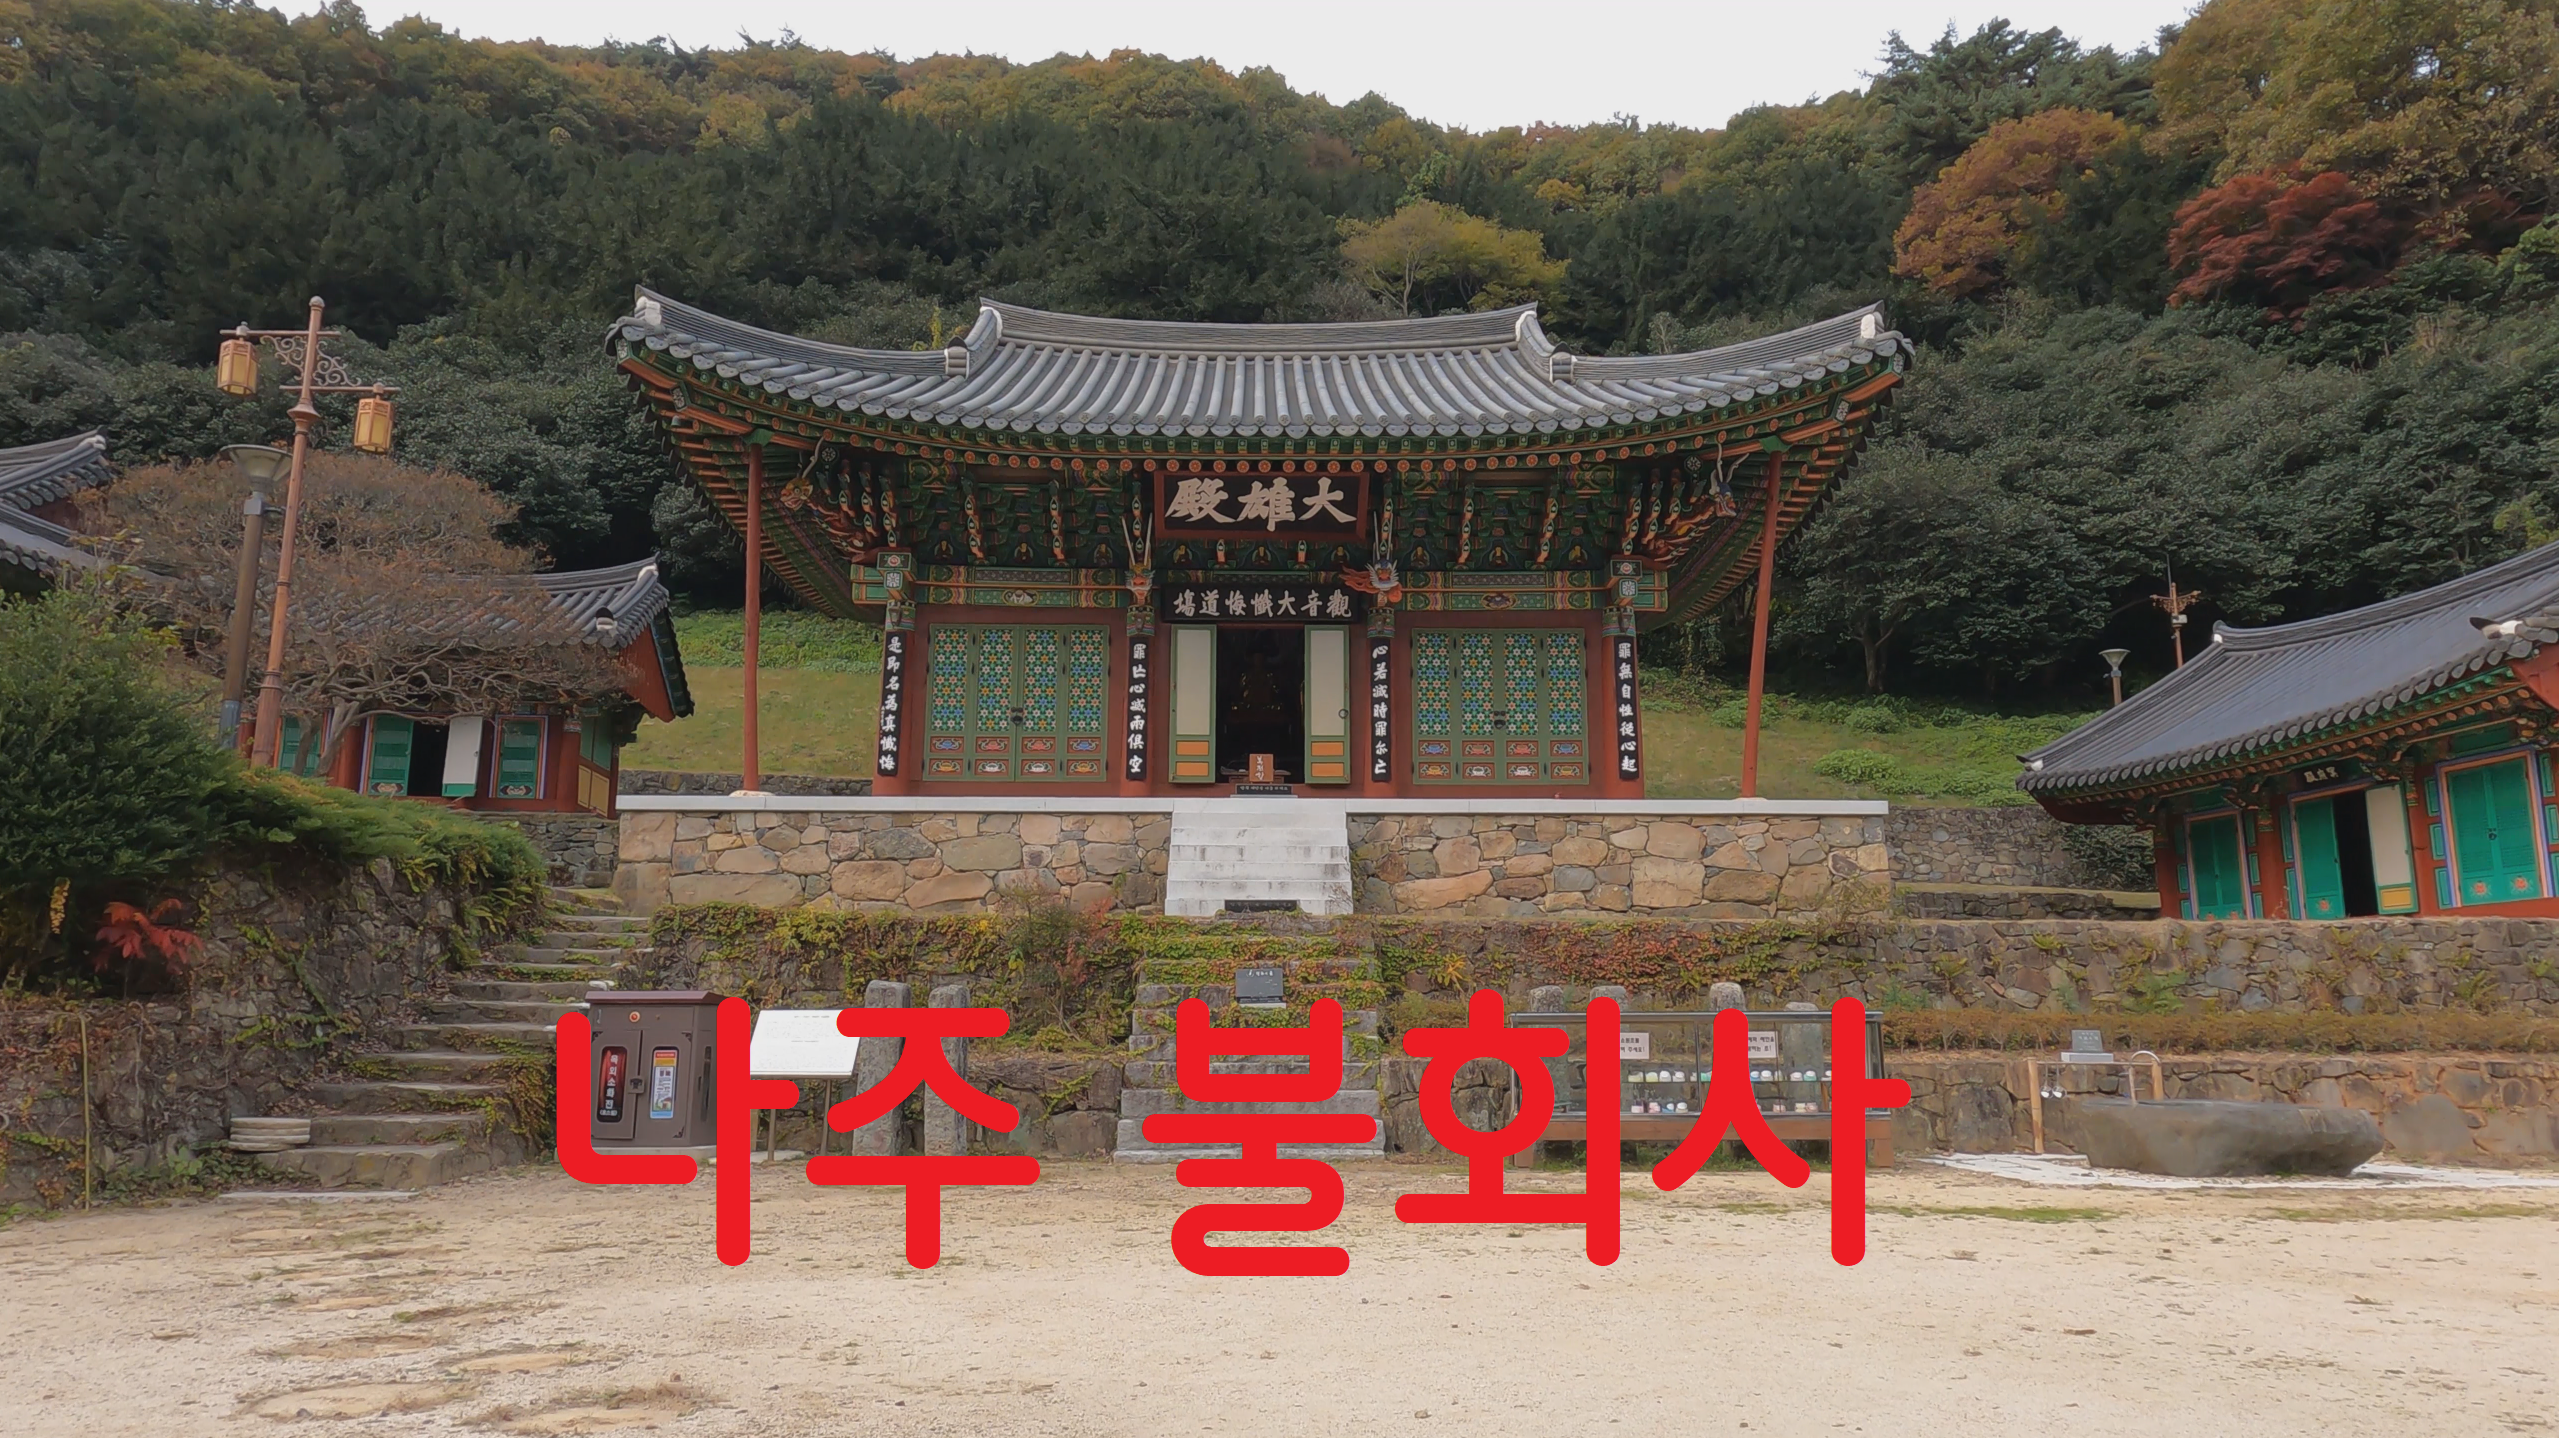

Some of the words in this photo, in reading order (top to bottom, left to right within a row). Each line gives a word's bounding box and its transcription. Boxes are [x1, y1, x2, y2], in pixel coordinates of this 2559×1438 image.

[1164, 476, 1358, 532] 大雄殿
[1618, 642, 1638, 772] 罪無自性從心起
[605, 1055, 619, 1109] 옥외소화전
